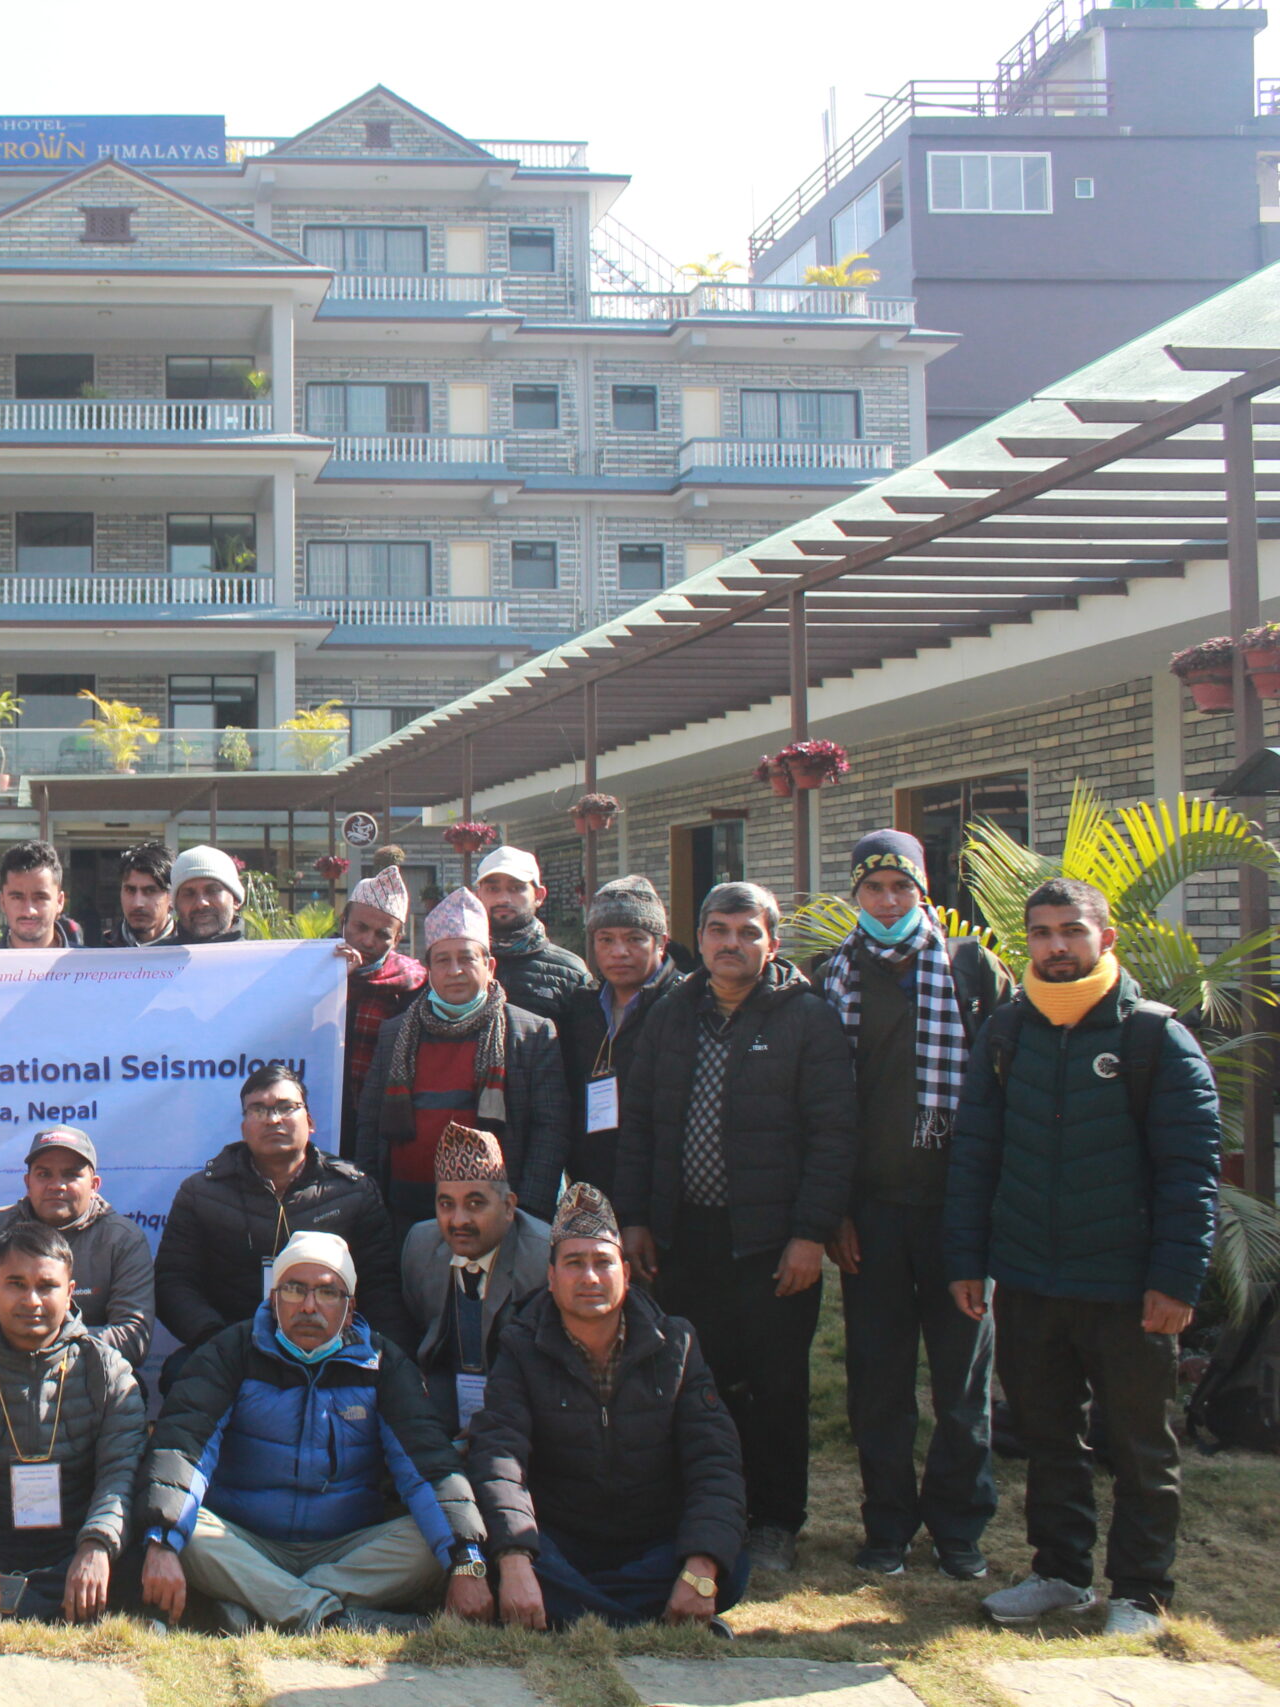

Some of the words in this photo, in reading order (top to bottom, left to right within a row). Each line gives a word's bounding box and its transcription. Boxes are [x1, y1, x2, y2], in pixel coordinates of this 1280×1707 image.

[3, 119, 66, 131] HOTEL
[96, 144, 220, 160] HIMALAYAS
[27, 967, 71, 983] better
[27, 1099, 98, 1123] Nepal
